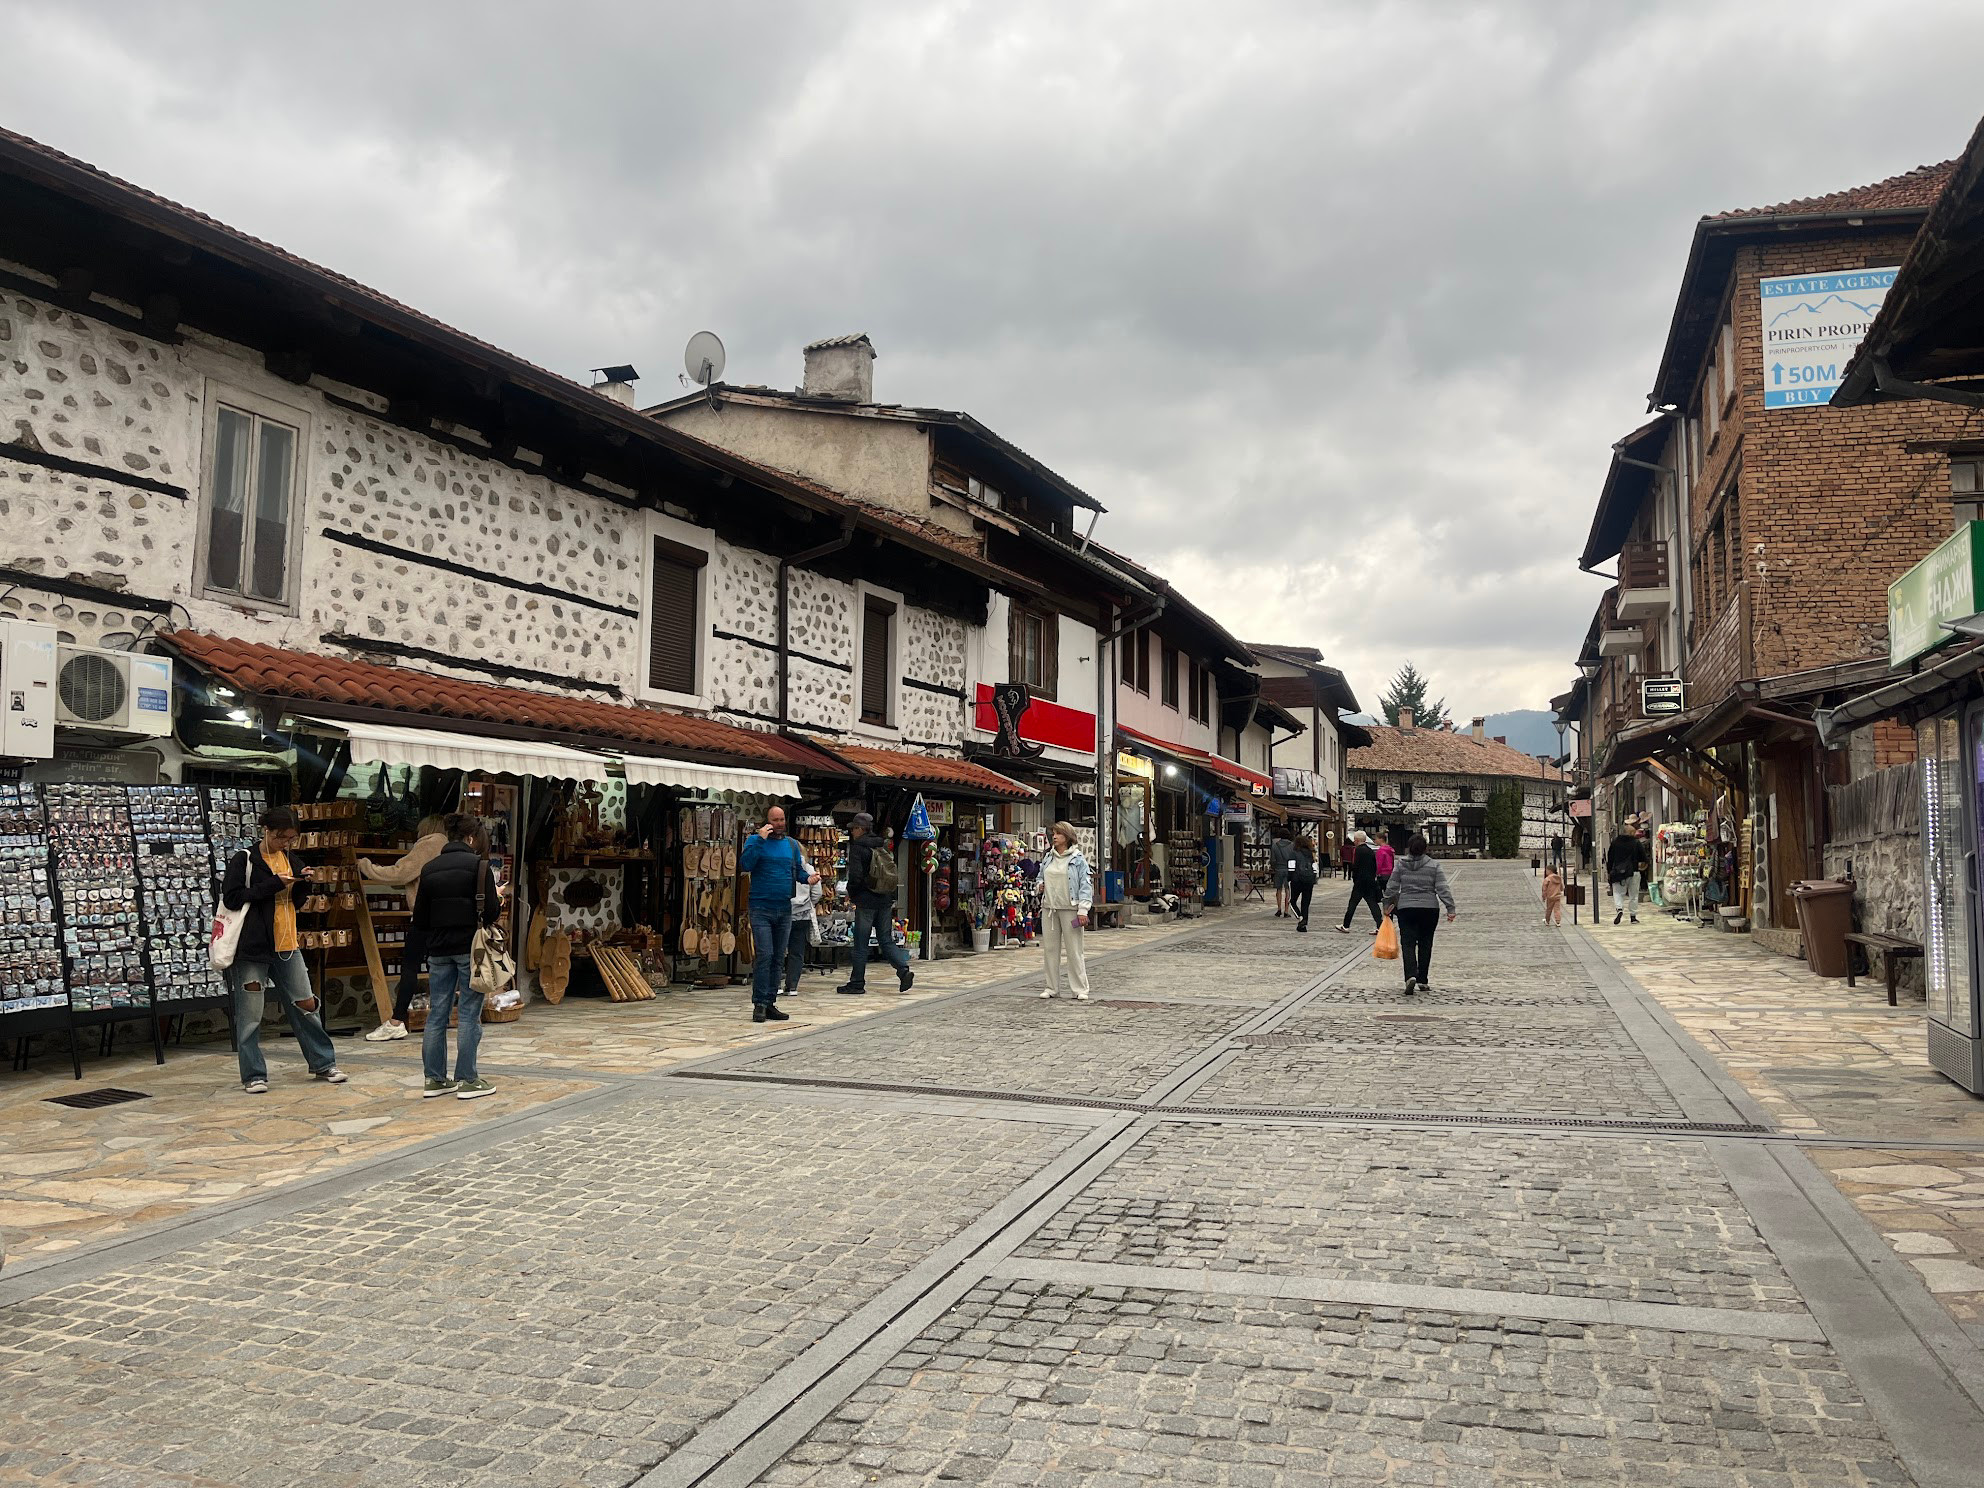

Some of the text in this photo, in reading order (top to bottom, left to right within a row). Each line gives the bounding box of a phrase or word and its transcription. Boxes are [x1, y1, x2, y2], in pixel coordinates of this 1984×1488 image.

[1764, 273, 1899, 295] ESTATE AGENC
[1768, 327, 1813, 341] PIRIN
[1768, 343, 1838, 355] PIRINPROPERTY.COM
[1788, 364, 1836, 384] 50M
[1785, 389, 1822, 403] BUY
[1926, 534, 1969, 579] МИНИМАРКЕТ
[1927, 560, 1971, 618] ЕНДЖИ
[104, 765, 122, 774] str.
[925, 801, 944, 813] GSM
